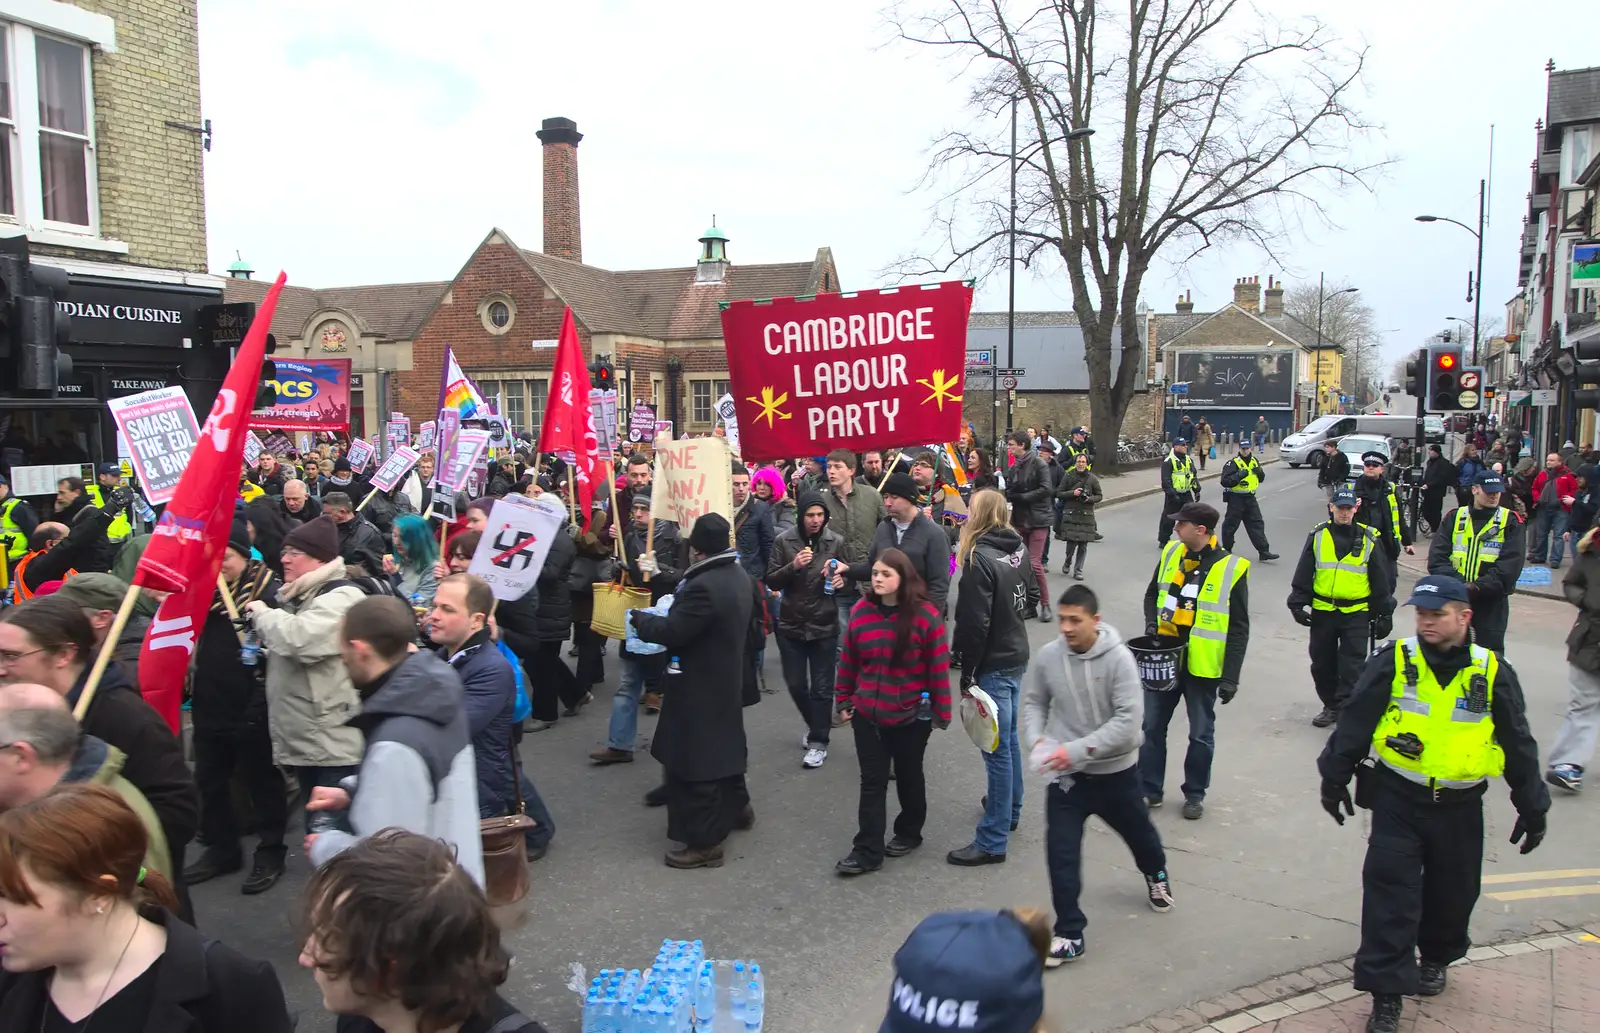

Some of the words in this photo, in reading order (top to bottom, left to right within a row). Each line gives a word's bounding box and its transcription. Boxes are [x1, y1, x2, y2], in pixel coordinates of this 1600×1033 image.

[56, 300, 110, 319] NDIAN
[113, 305, 182, 324] CUISINE
[763, 307, 934, 356] CAMBRIDGE
[287, 363, 313, 373] Region
[793, 353, 909, 398] LABOUR
[1214, 368, 1255, 391] sky
[112, 380, 167, 389] TAKEAWAY
[150, 391, 173, 402] Worker
[126, 410, 183, 440] SMASH
[284, 410, 320, 420] strength
[807, 398, 900, 441] PARTY
[133, 436, 168, 460] THE
[167, 428, 198, 451] EDL
[143, 460, 160, 480] &
[159, 450, 191, 475] BNP
[1139, 666, 1176, 680] UNITE
[893, 976, 980, 1029] POLICE
